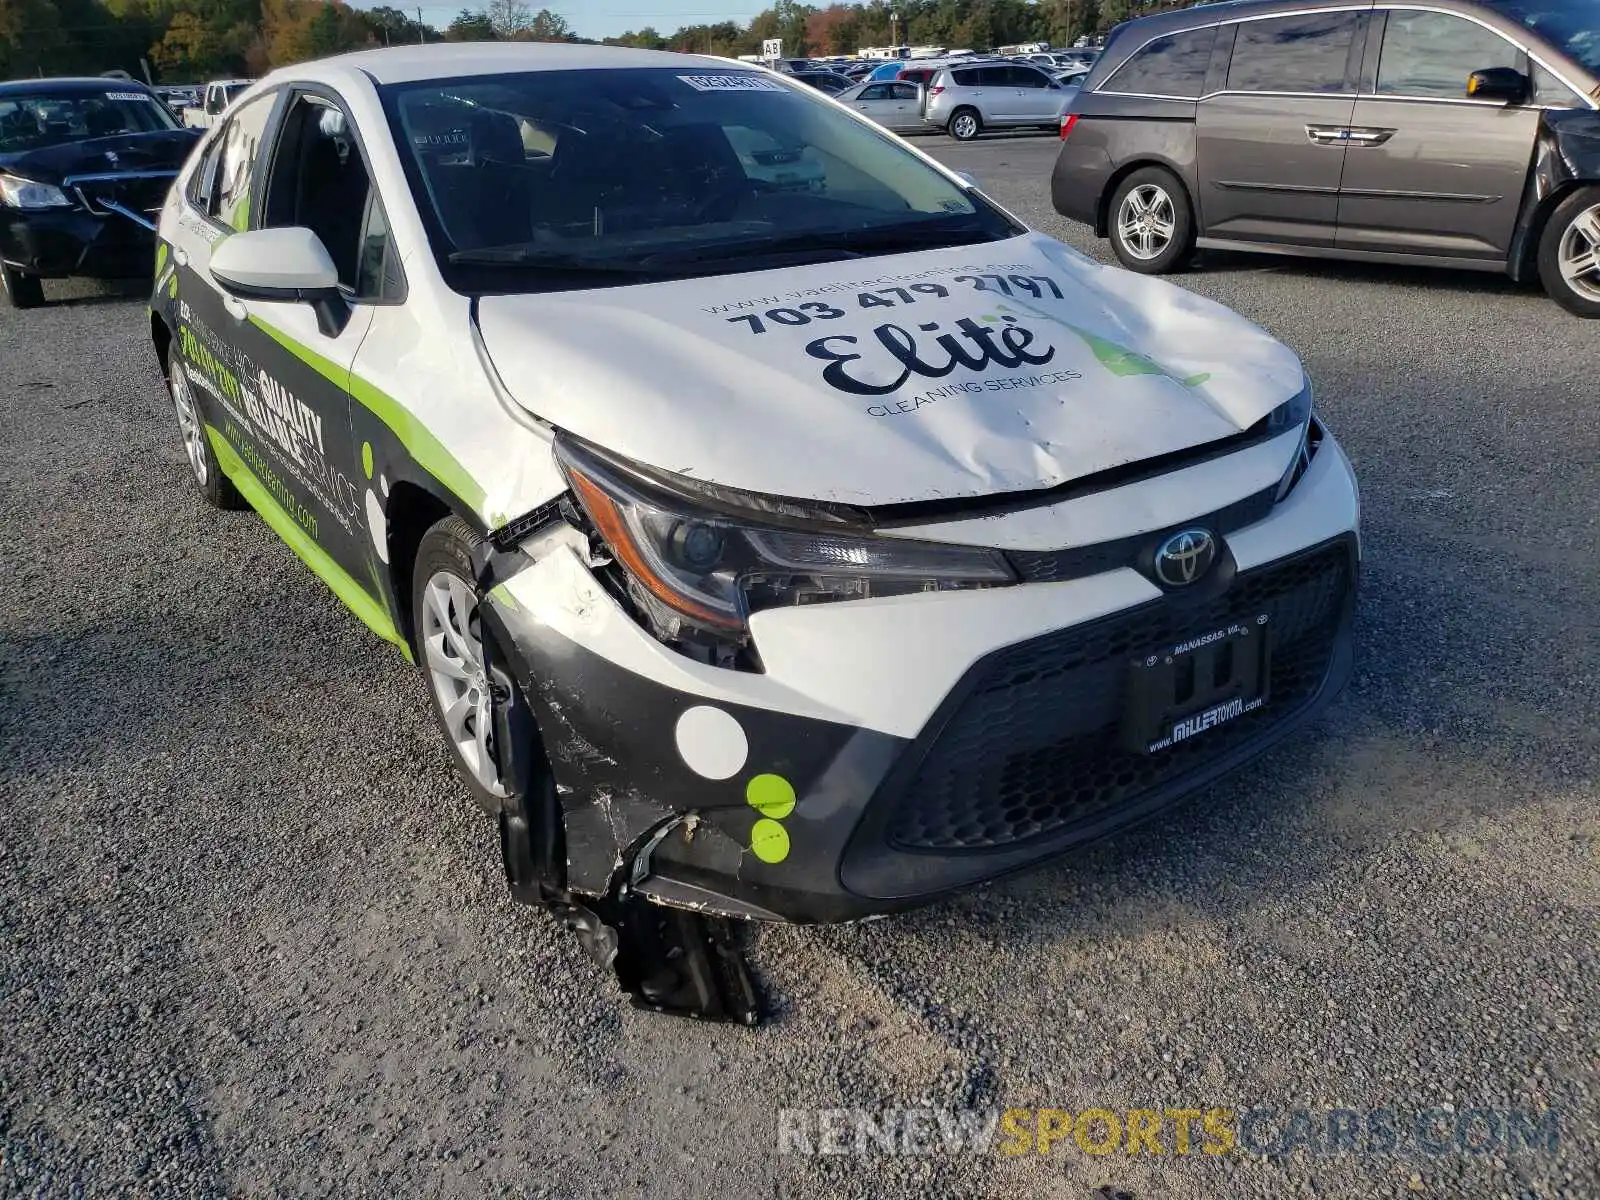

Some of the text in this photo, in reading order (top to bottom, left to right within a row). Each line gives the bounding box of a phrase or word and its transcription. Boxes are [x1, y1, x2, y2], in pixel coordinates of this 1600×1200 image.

[727, 274, 1065, 335] 703 479 2797
[260, 370, 325, 455] QUALITY
[866, 369, 1084, 418] CLEANING SERVICES
[240, 383, 306, 468] RELIABLE
[298, 436, 364, 529] SERVICE
